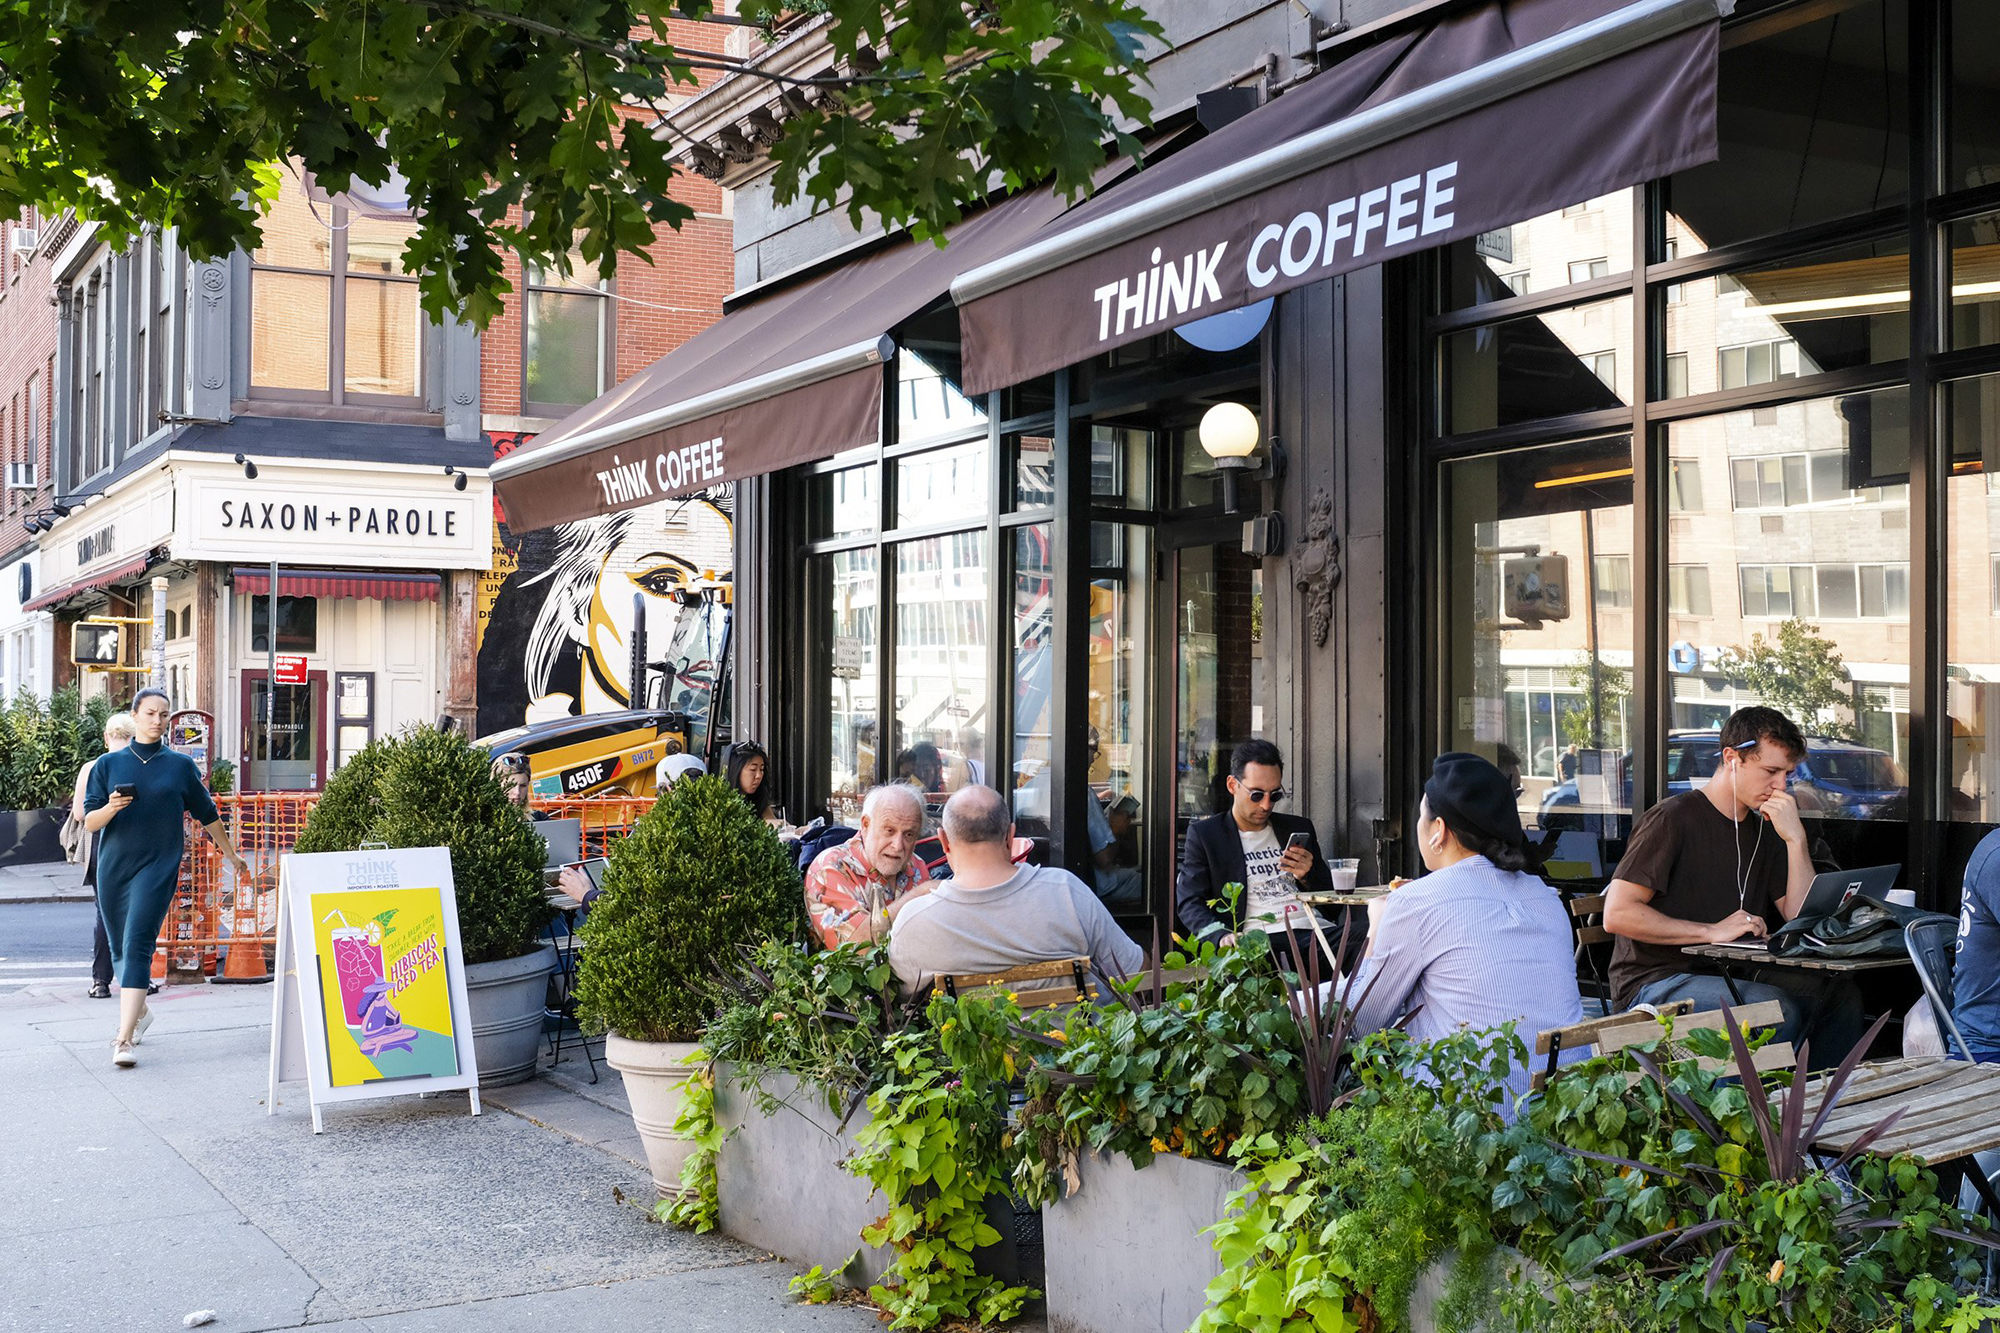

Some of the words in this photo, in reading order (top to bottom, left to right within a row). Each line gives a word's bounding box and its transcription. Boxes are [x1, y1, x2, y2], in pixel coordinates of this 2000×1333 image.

[1246, 161, 1458, 289] COFFEE
[655, 436, 724, 491] COFFEE
[568, 762, 604, 791] 450F
[632, 749, 655, 766] BH72
[347, 873, 399, 885] COFFEE
[387, 938, 401, 953] TAKE
[390, 933, 438, 982] HIBISCUS
[392, 969, 418, 999] ICED
[418, 950, 441, 974] TEA
